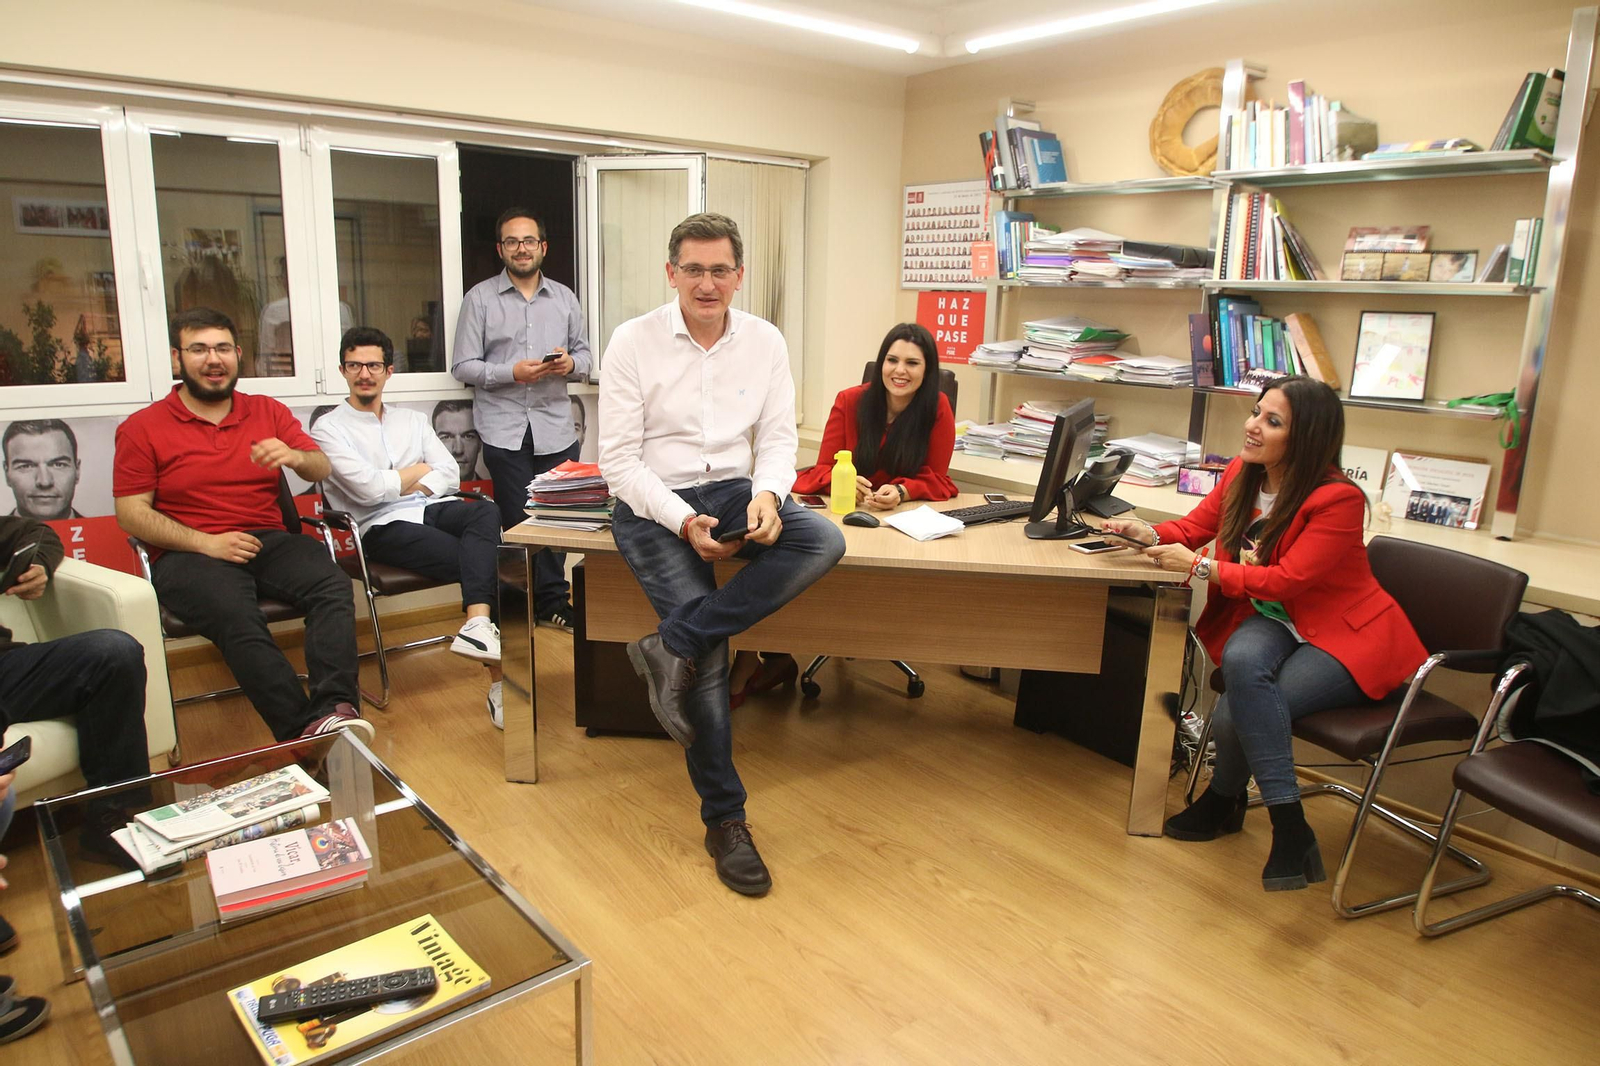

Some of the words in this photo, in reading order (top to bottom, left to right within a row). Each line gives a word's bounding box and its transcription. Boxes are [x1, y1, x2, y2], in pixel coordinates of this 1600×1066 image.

[938, 297, 970, 310] HAZ
[937, 313, 969, 326] QUE
[936, 329, 968, 343] PASE
[409, 920, 472, 986] Vintage
